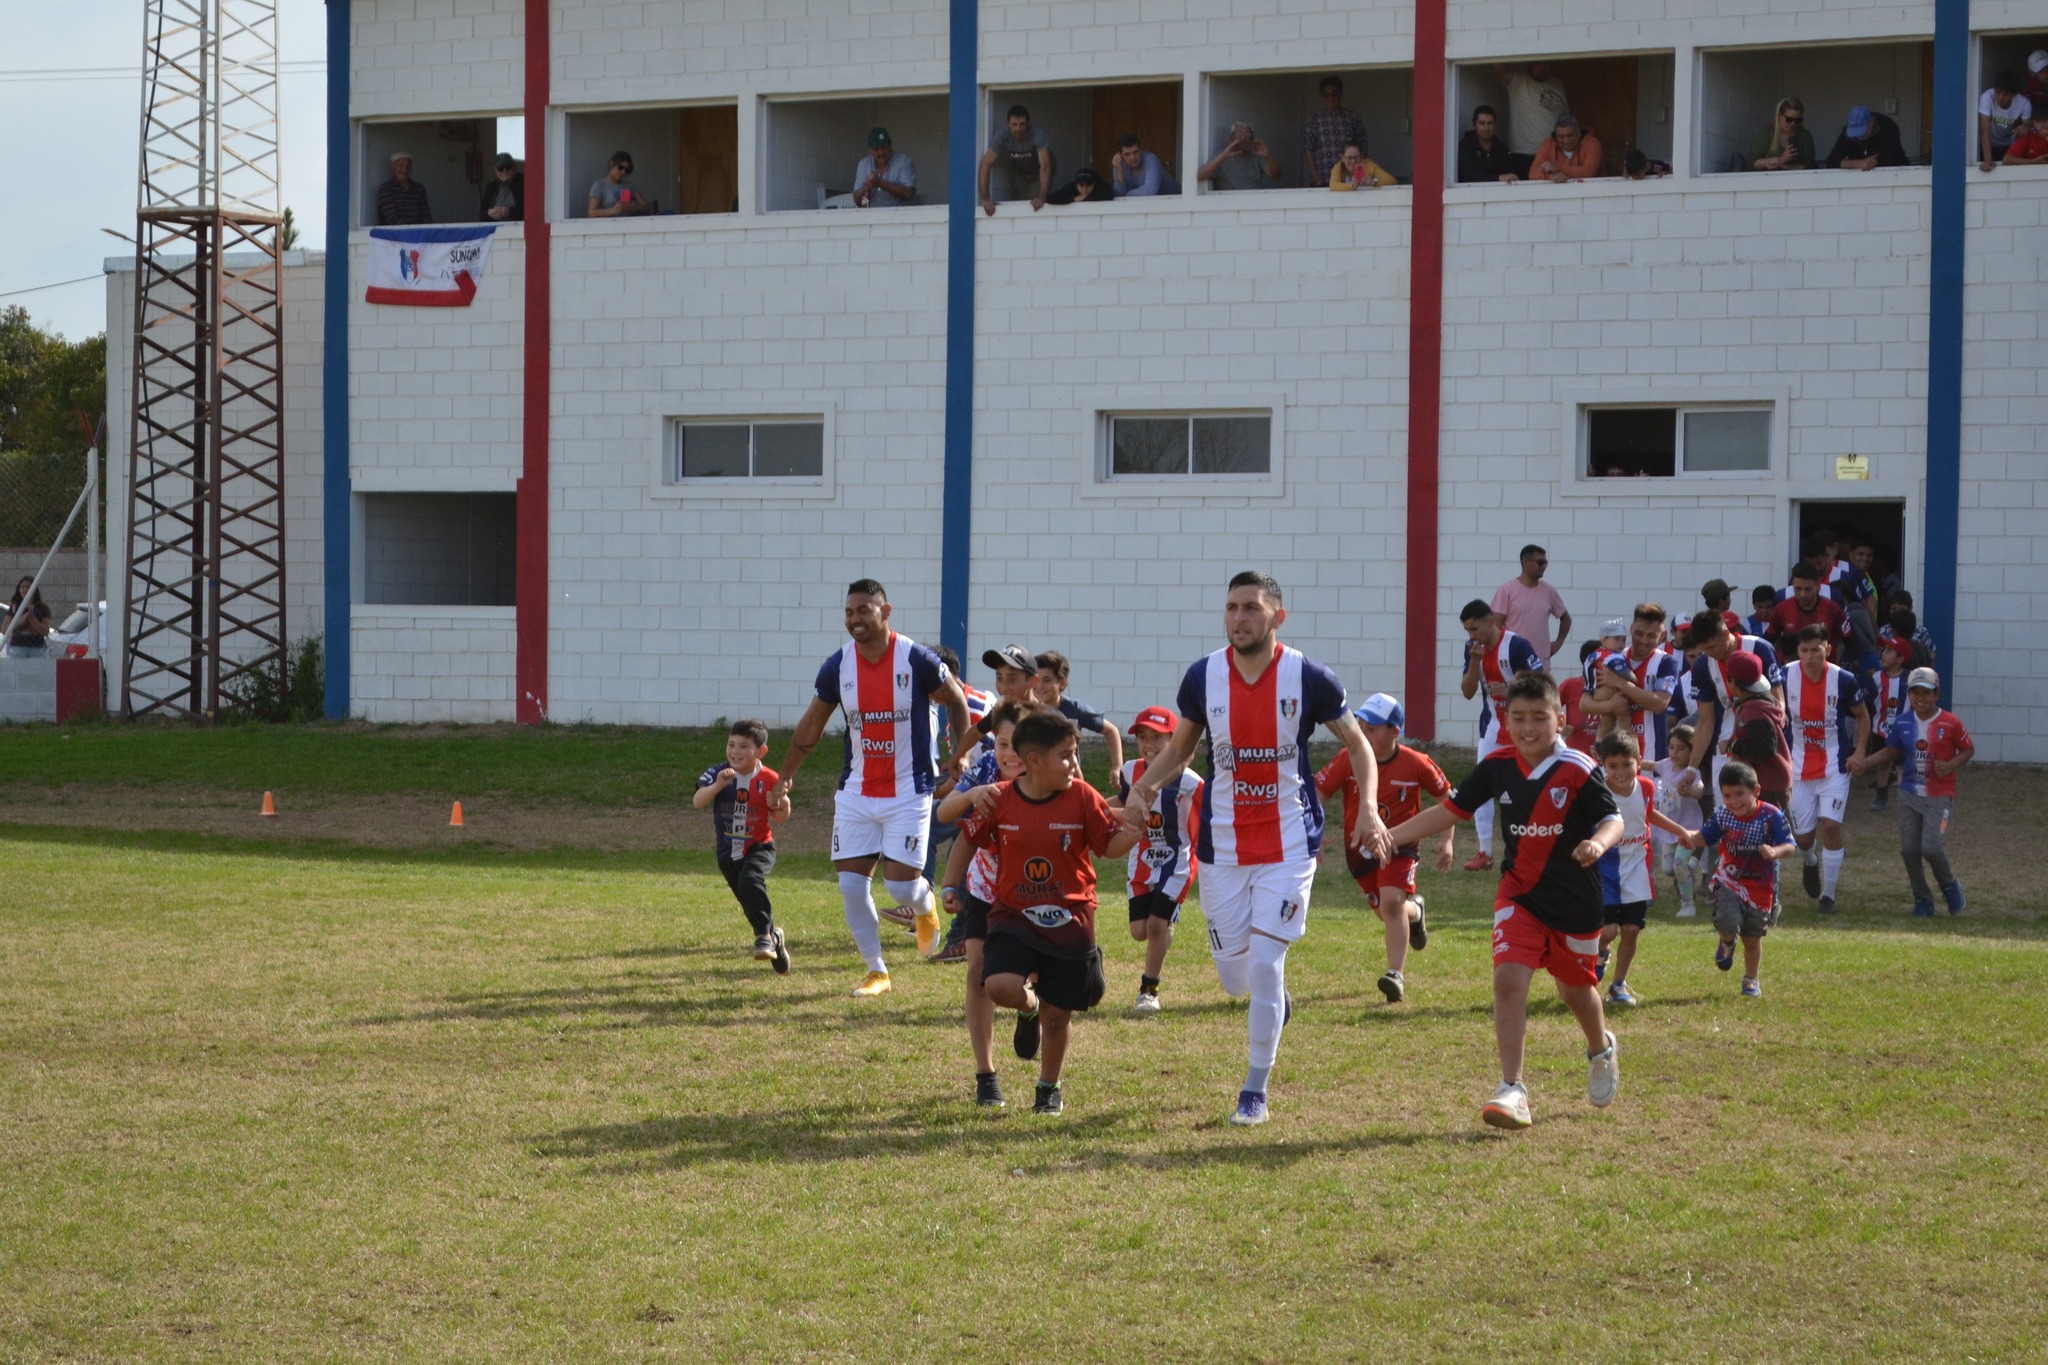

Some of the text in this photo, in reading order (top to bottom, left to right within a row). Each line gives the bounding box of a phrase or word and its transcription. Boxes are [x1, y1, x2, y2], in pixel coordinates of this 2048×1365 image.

[864, 709, 910, 720] MURAT
[861, 738, 895, 754] Rwg
[1239, 745, 1296, 758] MURAT
[1233, 781, 1278, 799] Rwg
[1510, 822, 1564, 837] codere
[833, 834, 840, 852] 9
[1029, 862, 1049, 878] M
[1209, 928, 1223, 950] 11
